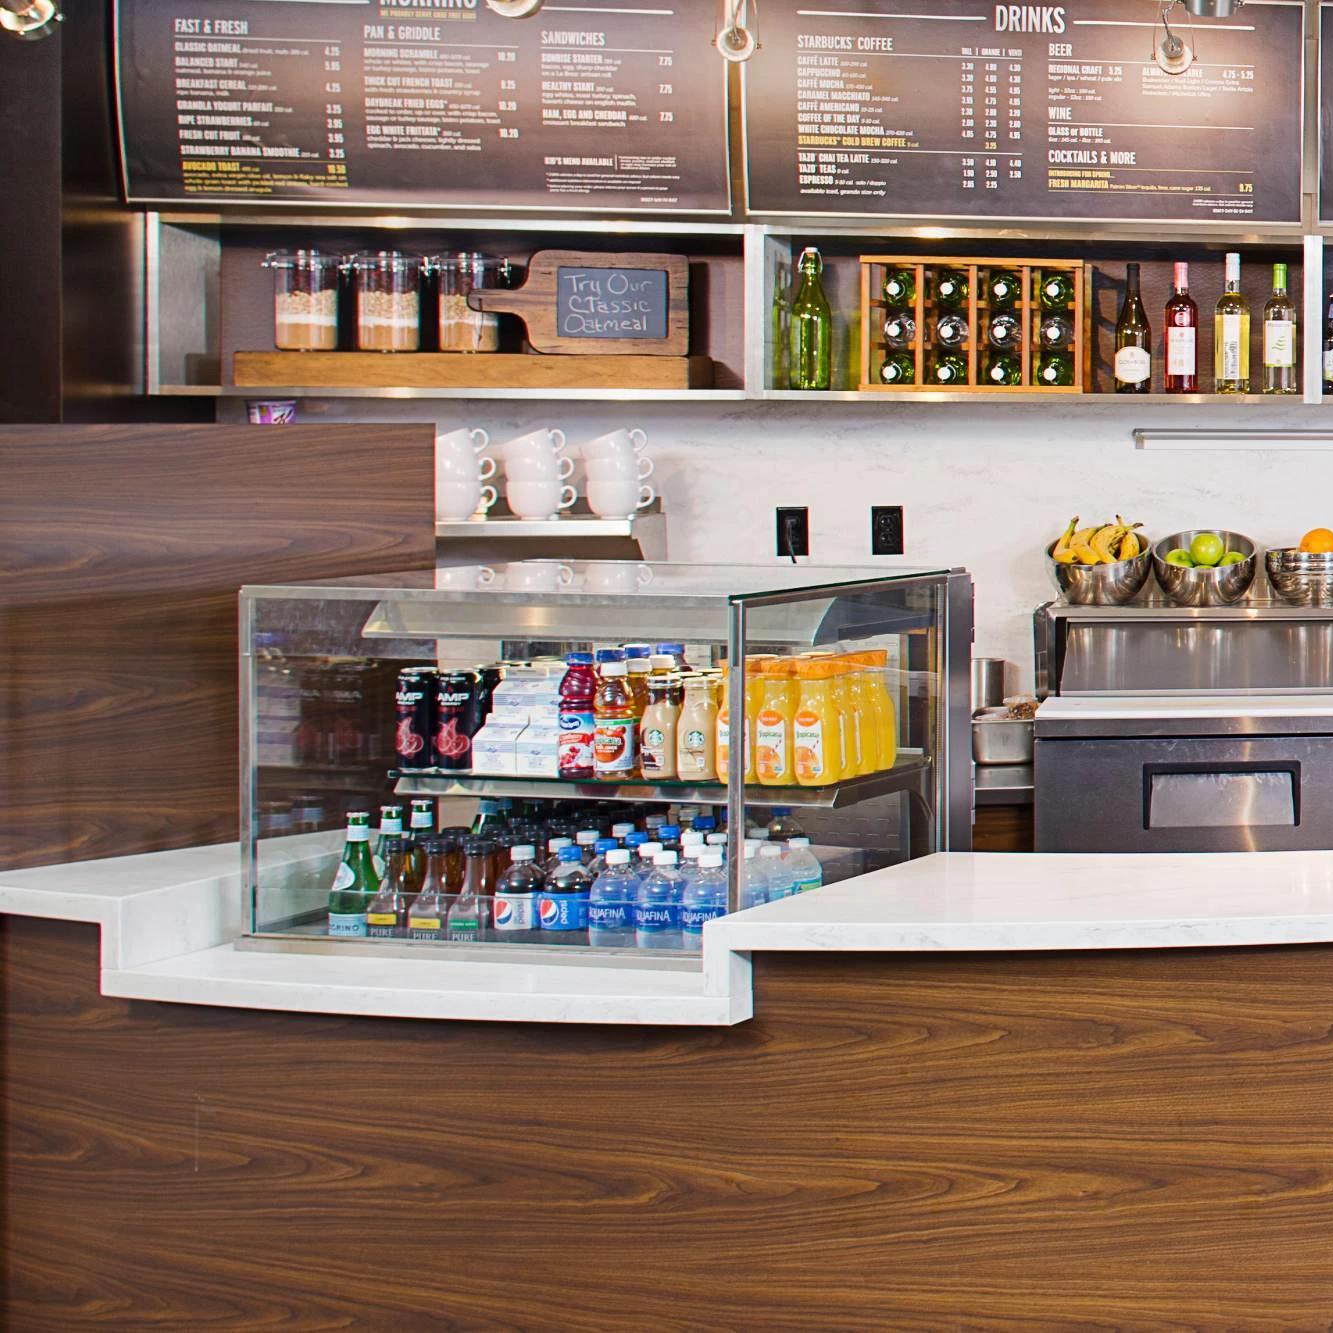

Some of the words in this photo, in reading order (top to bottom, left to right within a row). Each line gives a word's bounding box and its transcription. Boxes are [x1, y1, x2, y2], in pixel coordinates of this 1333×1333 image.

[995, 5, 1066, 34] DRINKS
[175, 19, 200, 33] FAST
[203, 21, 211, 33] &
[215, 20, 248, 34] FRESH
[364, 25, 384, 39] PAN
[388, 27, 396, 39] &
[399, 27, 440, 40] GRIDDLE
[541, 31, 605, 46] SANDWICHES
[858, 37, 893, 50] COFFEE
[207, 43, 240, 53] OATMEAL
[1048, 44, 1072, 57] BEER
[175, 57, 214, 67] BALANCED
[216, 58, 238, 68] START
[176, 78, 218, 89] BREAKFAST
[219, 80, 246, 90] CEREAL
[542, 81, 572, 91] HEALTHY
[573, 82, 594, 91] START
[798, 113, 821, 123] COFFEE
[823, 114, 832, 123] OF
[834, 114, 845, 123] THE
[847, 115, 860, 124] DAY
[1048, 107, 1071, 119] WINE
[179, 130, 202, 140] FRESH
[204, 130, 218, 140] CUT
[798, 124, 819, 134] WHITE
[820, 125, 858, 135] CHOCOLATE
[860, 126, 884, 136] MOCHA
[1048, 127, 1069, 136] GLASS
[1071, 128, 1077, 136] or
[1079, 128, 1103, 137] BOTTLE
[1048, 150, 1098, 164] COCKTAILS
[1101, 151, 1107, 163] &
[1110, 152, 1136, 165] MORE
[218, 162, 240, 171] TOAST
[799, 175, 833, 185] ESPRESSO
[1048, 179, 1069, 188] FRESH
[1071, 180, 1109, 189] MARGARITA
[564, 274, 601, 295] Try
[608, 274, 653, 295] Our
[564, 314, 647, 333] Oatmeal
[438, 693, 469, 701] AMP
